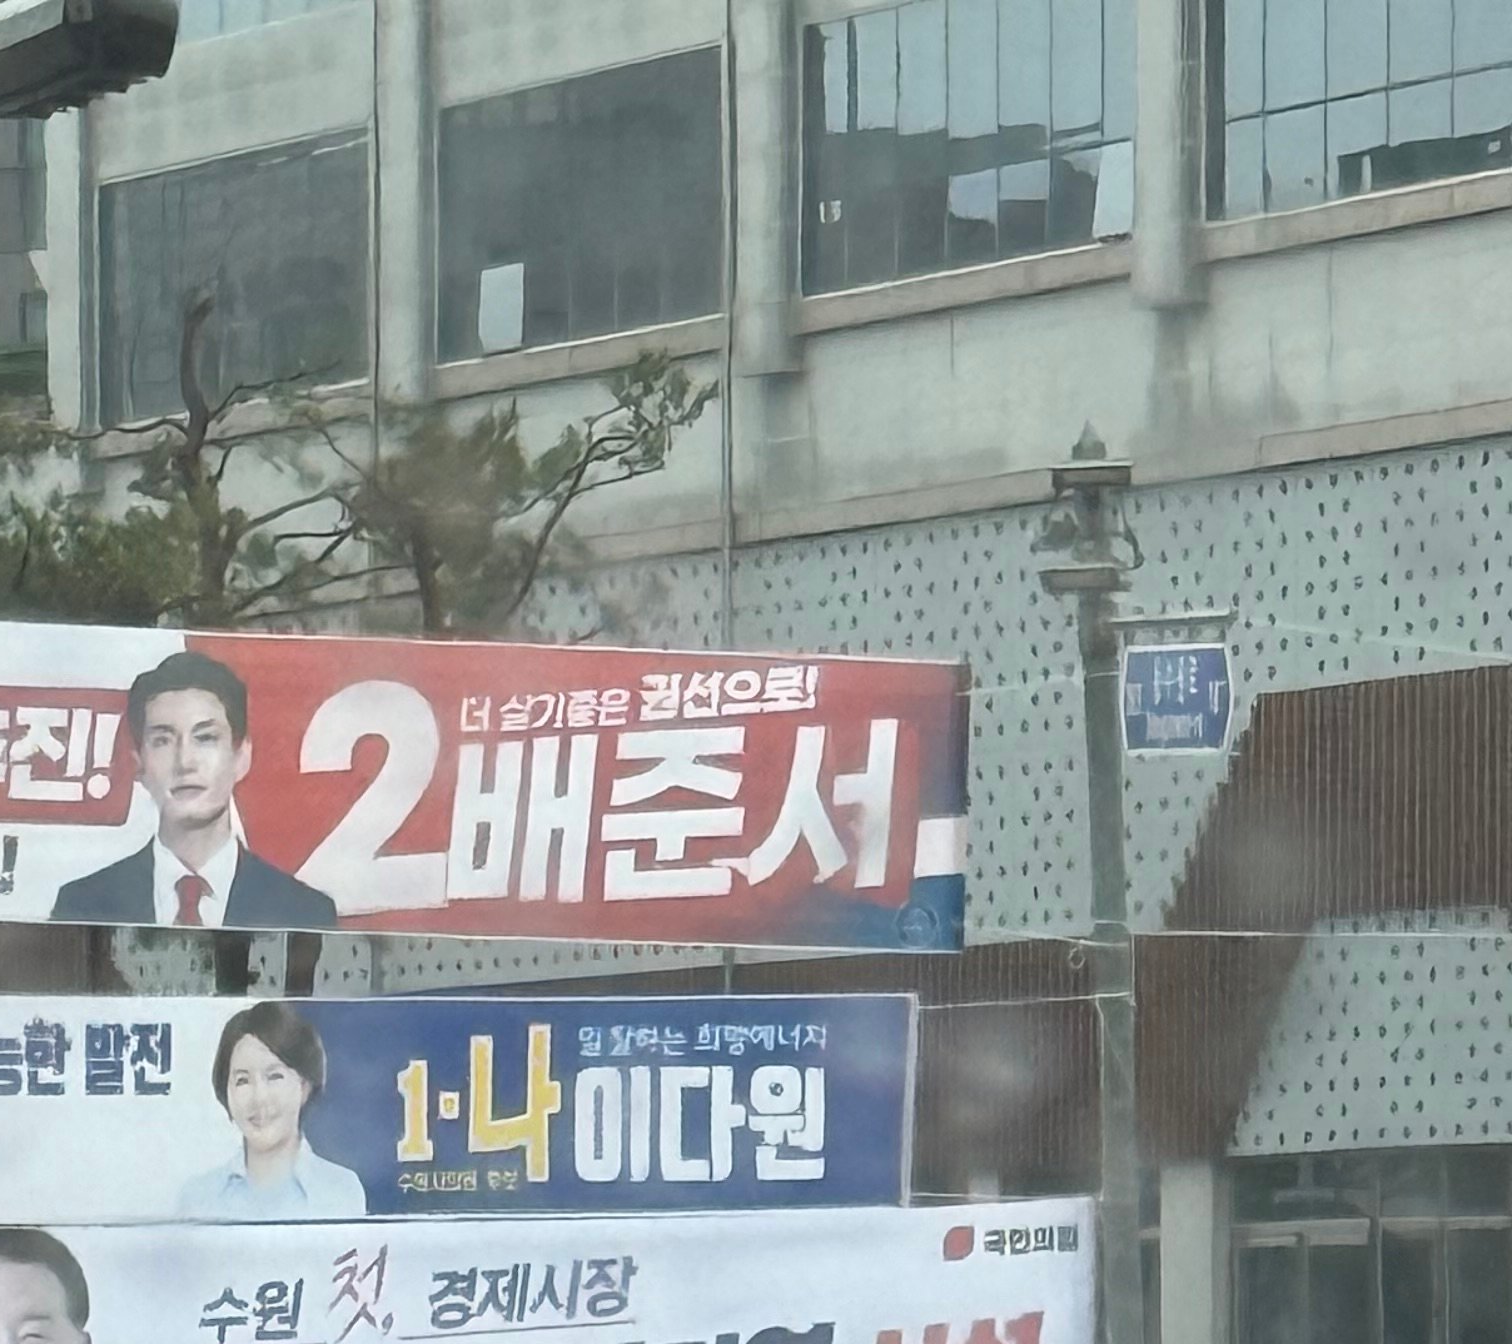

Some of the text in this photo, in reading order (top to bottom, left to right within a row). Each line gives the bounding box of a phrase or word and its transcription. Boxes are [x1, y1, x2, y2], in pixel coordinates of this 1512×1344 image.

[460, 665, 820, 732] 더 살기좋은 권선으로!
[294, 680, 898, 916] 2 배준서
[85, 1022, 172, 1096] 발전
[574, 1065, 826, 1182] 이다원
[198, 1277, 304, 1344] 수원
[428, 1255, 639, 1330] 경제시장
